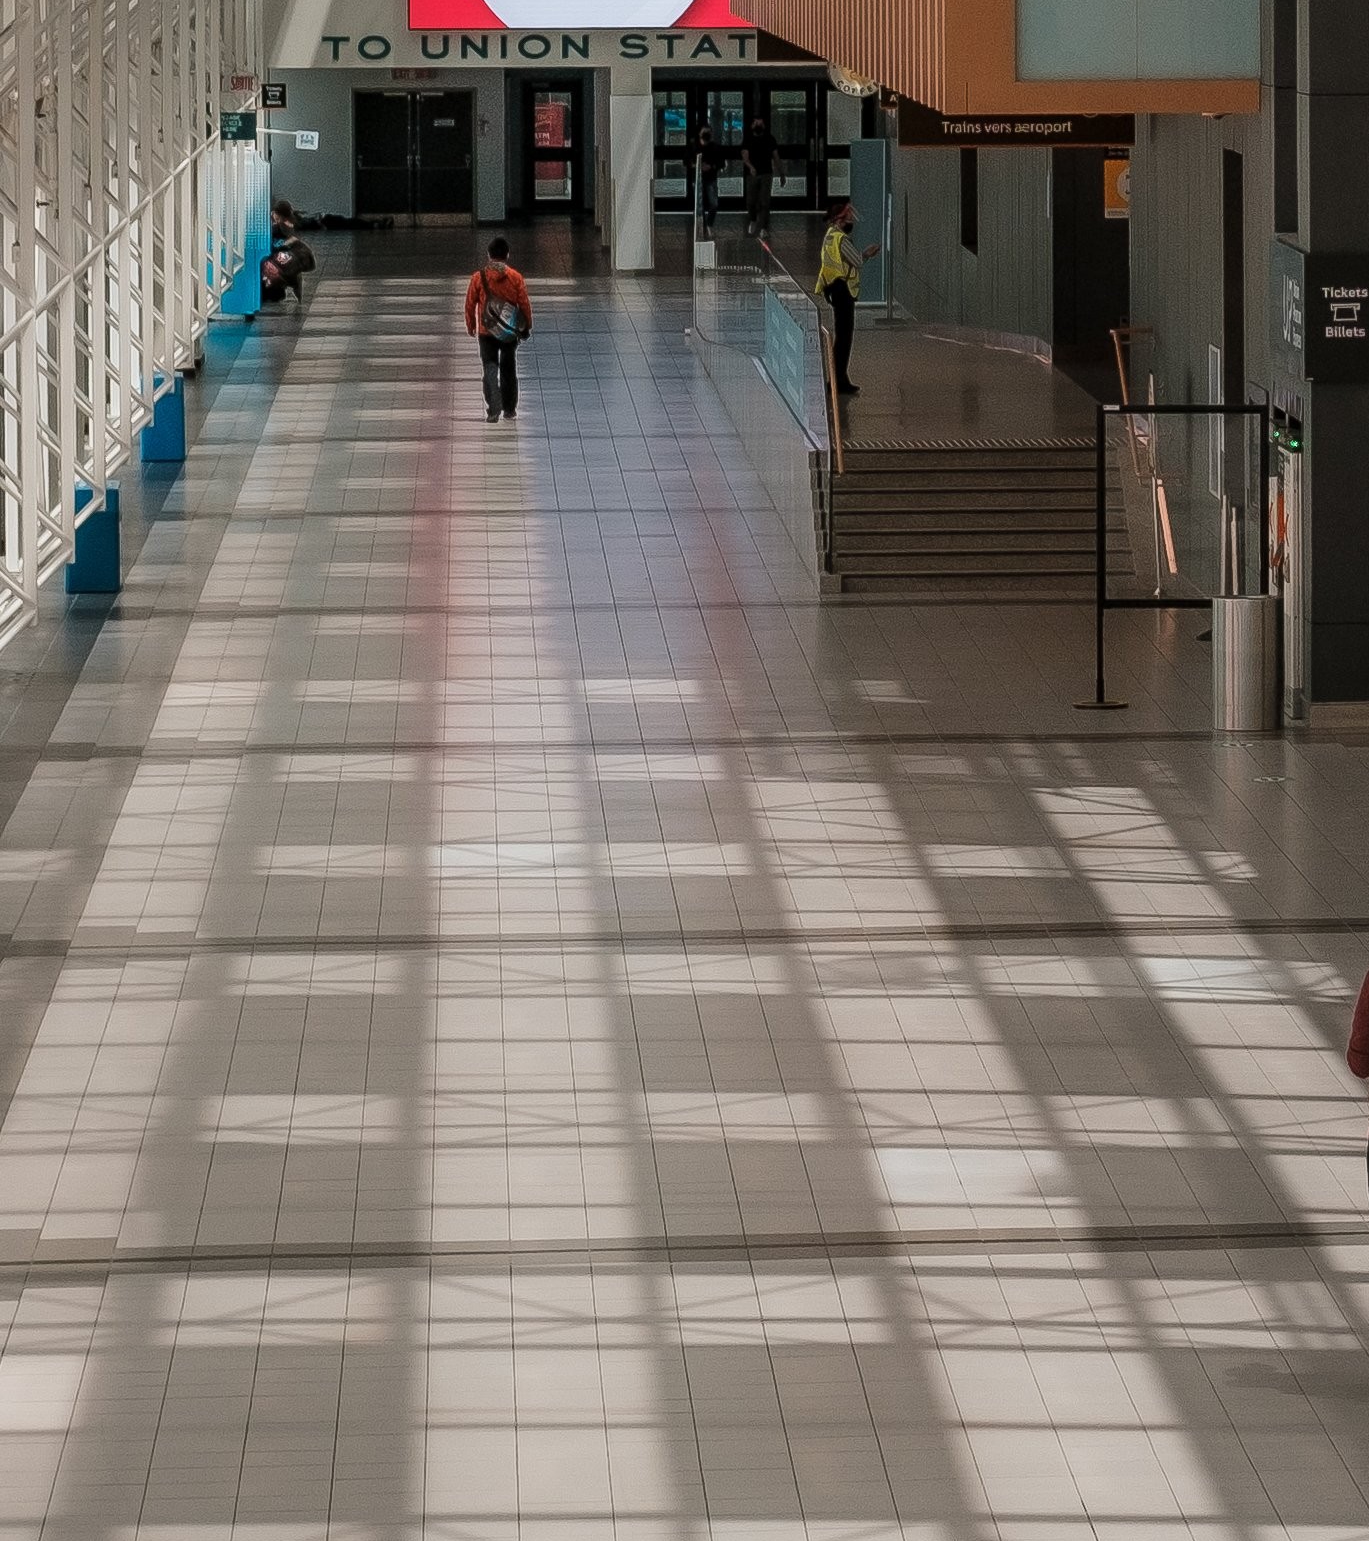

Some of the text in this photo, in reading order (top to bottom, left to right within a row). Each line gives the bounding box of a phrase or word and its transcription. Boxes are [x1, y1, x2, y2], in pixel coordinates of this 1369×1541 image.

[321, 35, 392, 62] TO
[421, 34, 590, 61] UNION
[941, 120, 982, 134] Trains
[984, 122, 1012, 134] vers
[1321, 286, 1369, 299] Tickets
[1325, 326, 1366, 338] Billets
